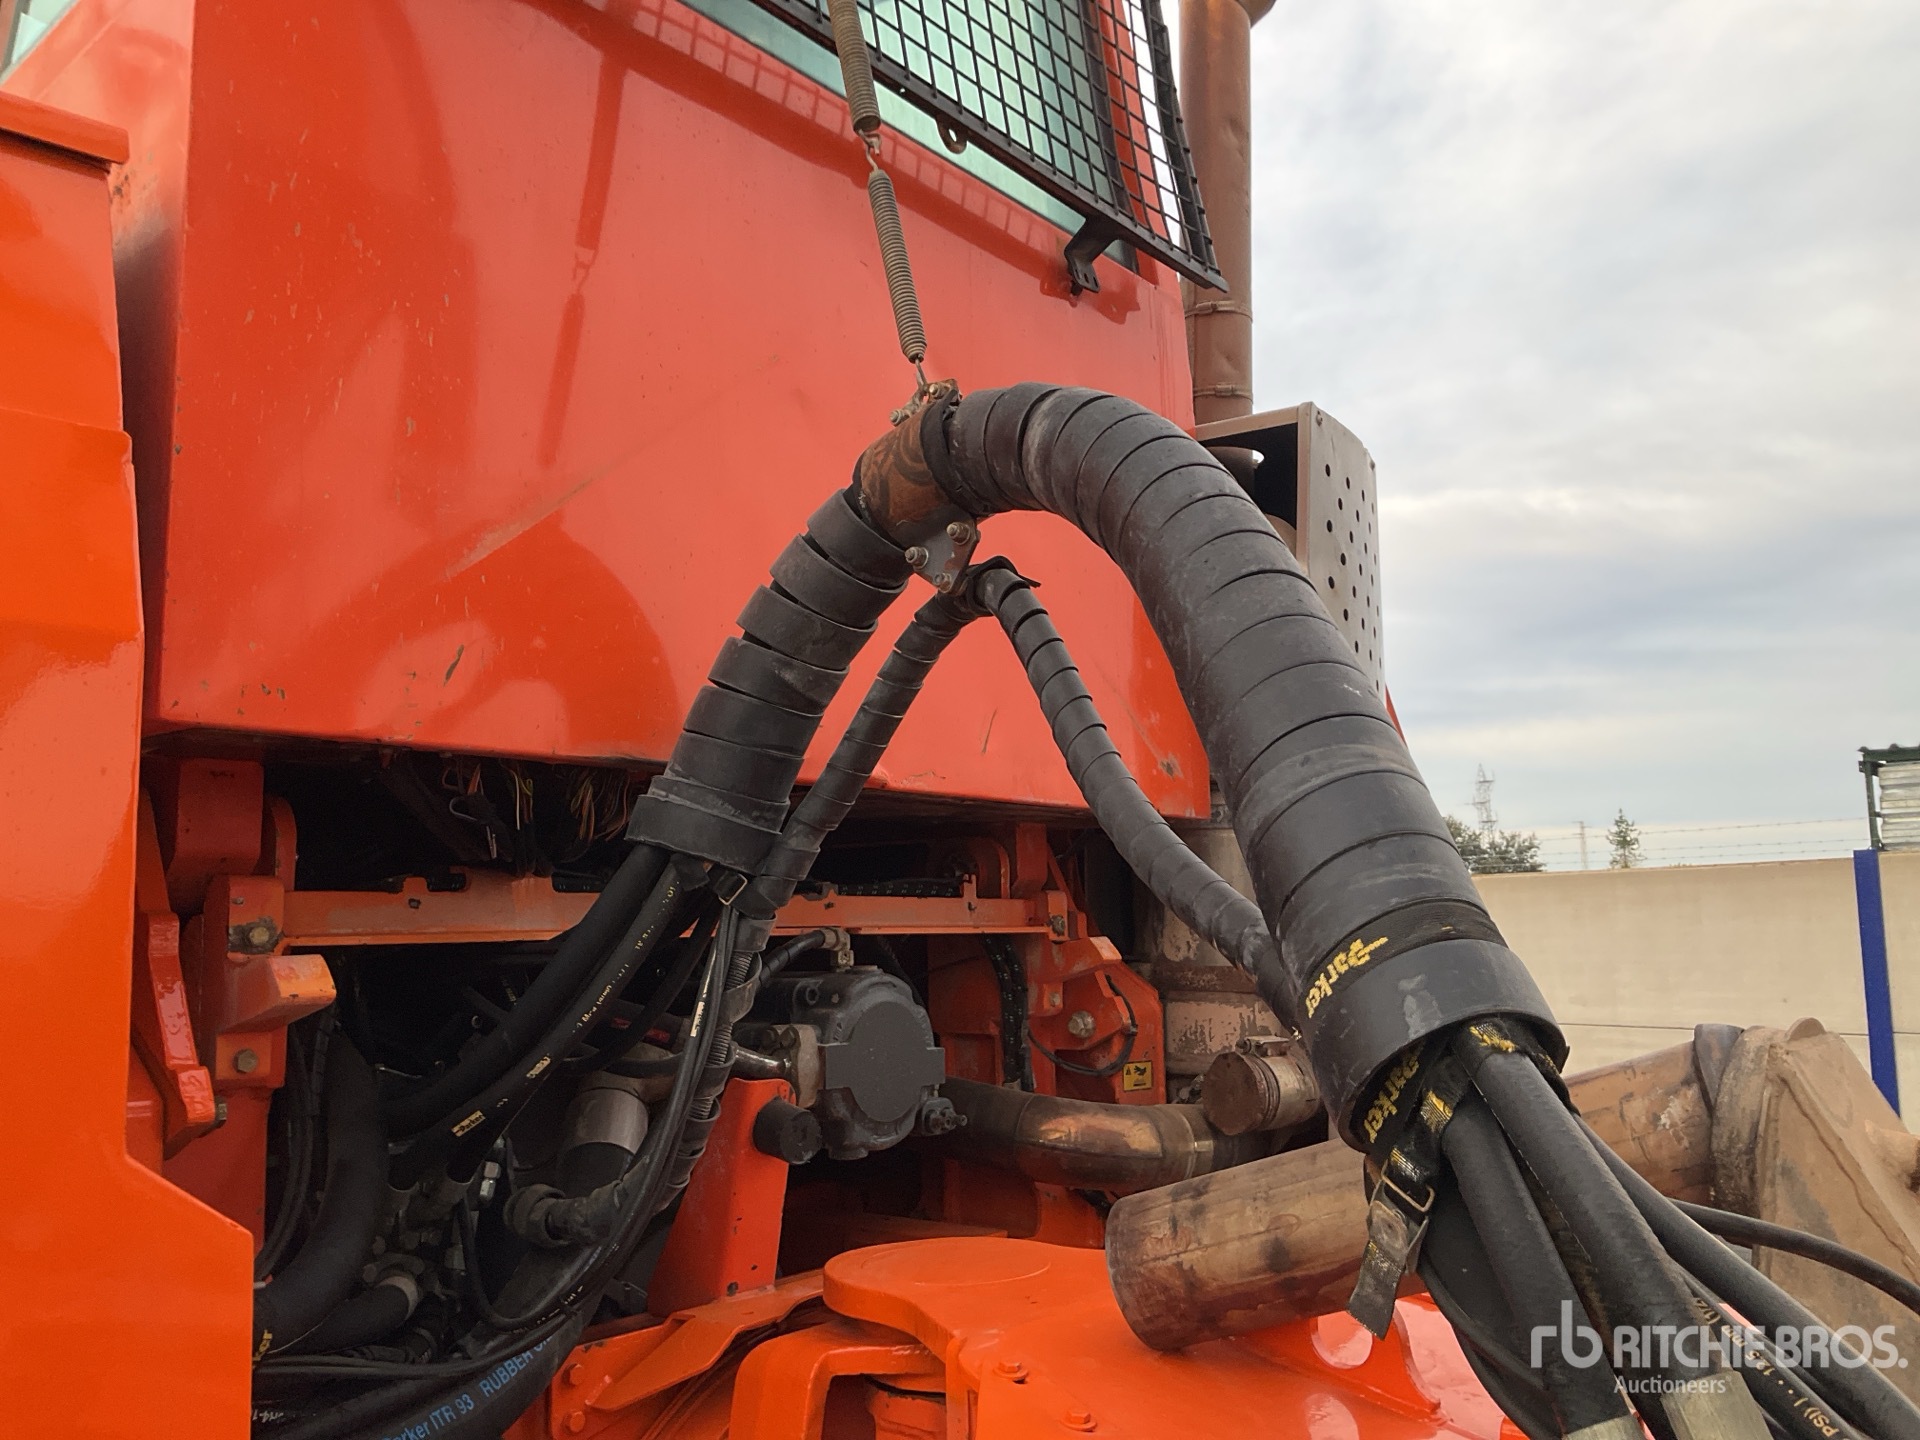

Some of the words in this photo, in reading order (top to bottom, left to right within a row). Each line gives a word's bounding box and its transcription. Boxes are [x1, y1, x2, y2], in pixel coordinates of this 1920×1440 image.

[1305, 936, 1389, 1018] Parker
[452, 1110, 486, 1137] Parker
[429, 1405, 456, 1430] ITR
[455, 1393, 474, 1415] 93
[479, 1351, 533, 1398] RUBBER
